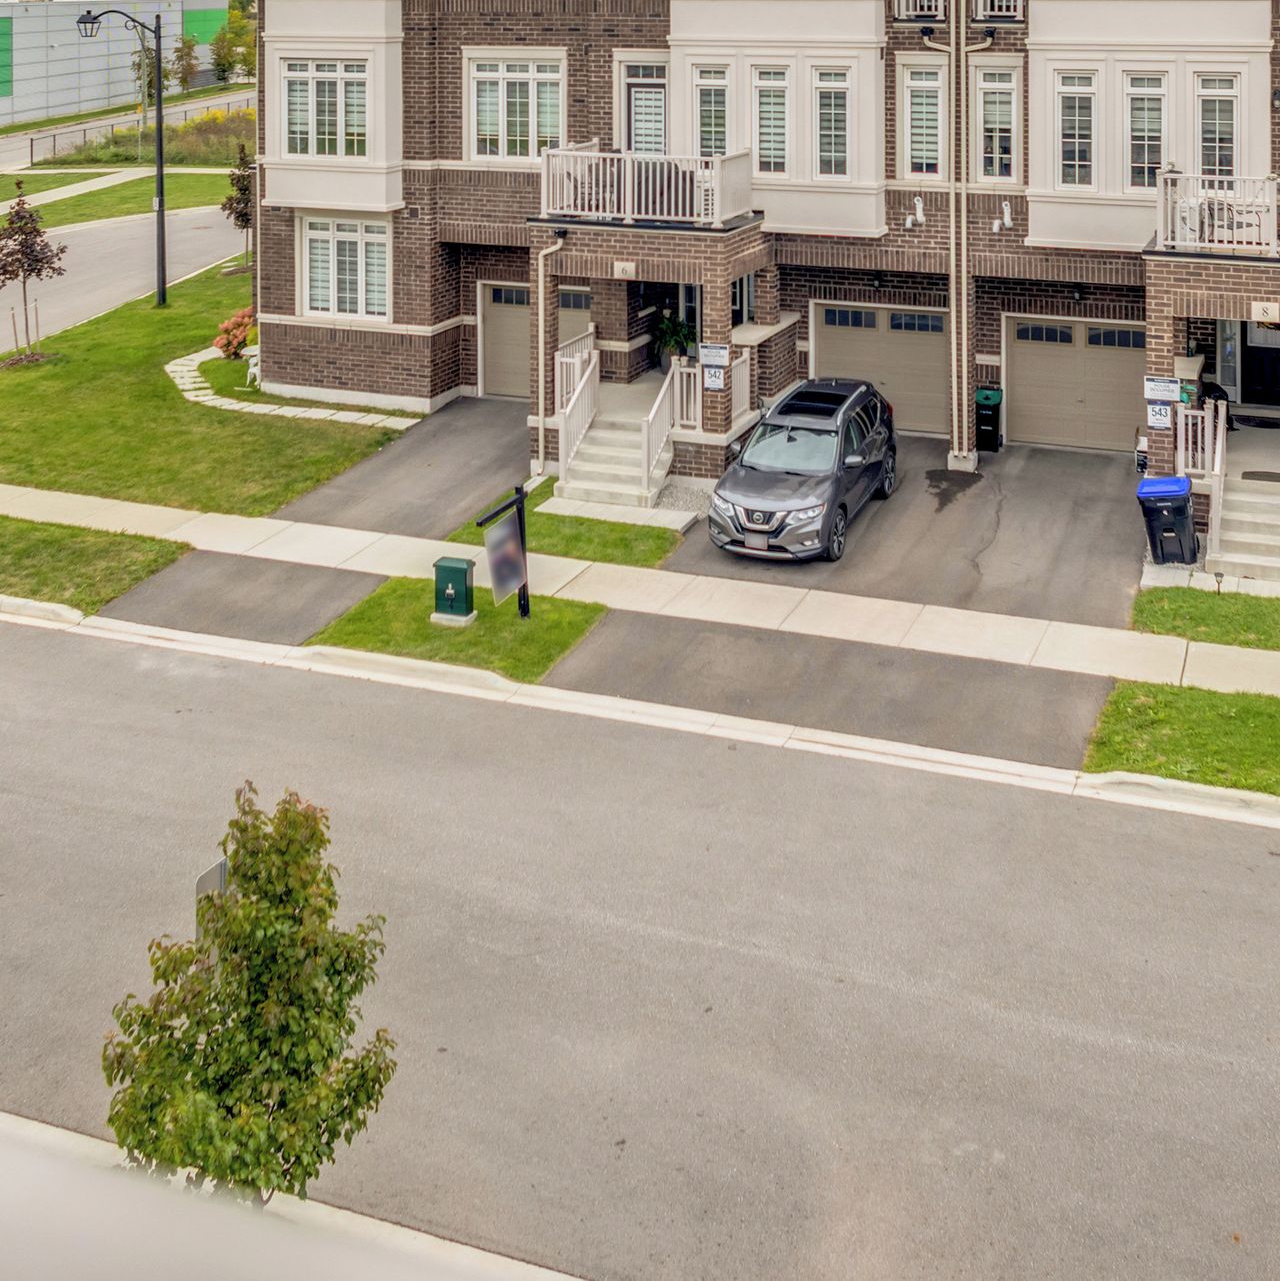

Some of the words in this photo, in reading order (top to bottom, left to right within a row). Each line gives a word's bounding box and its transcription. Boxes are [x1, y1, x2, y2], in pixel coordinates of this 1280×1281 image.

[621, 266, 628, 275] 6
[1262, 306, 1269, 317] 8
[707, 369, 722, 380] 542
[1151, 407, 1168, 418] 543
